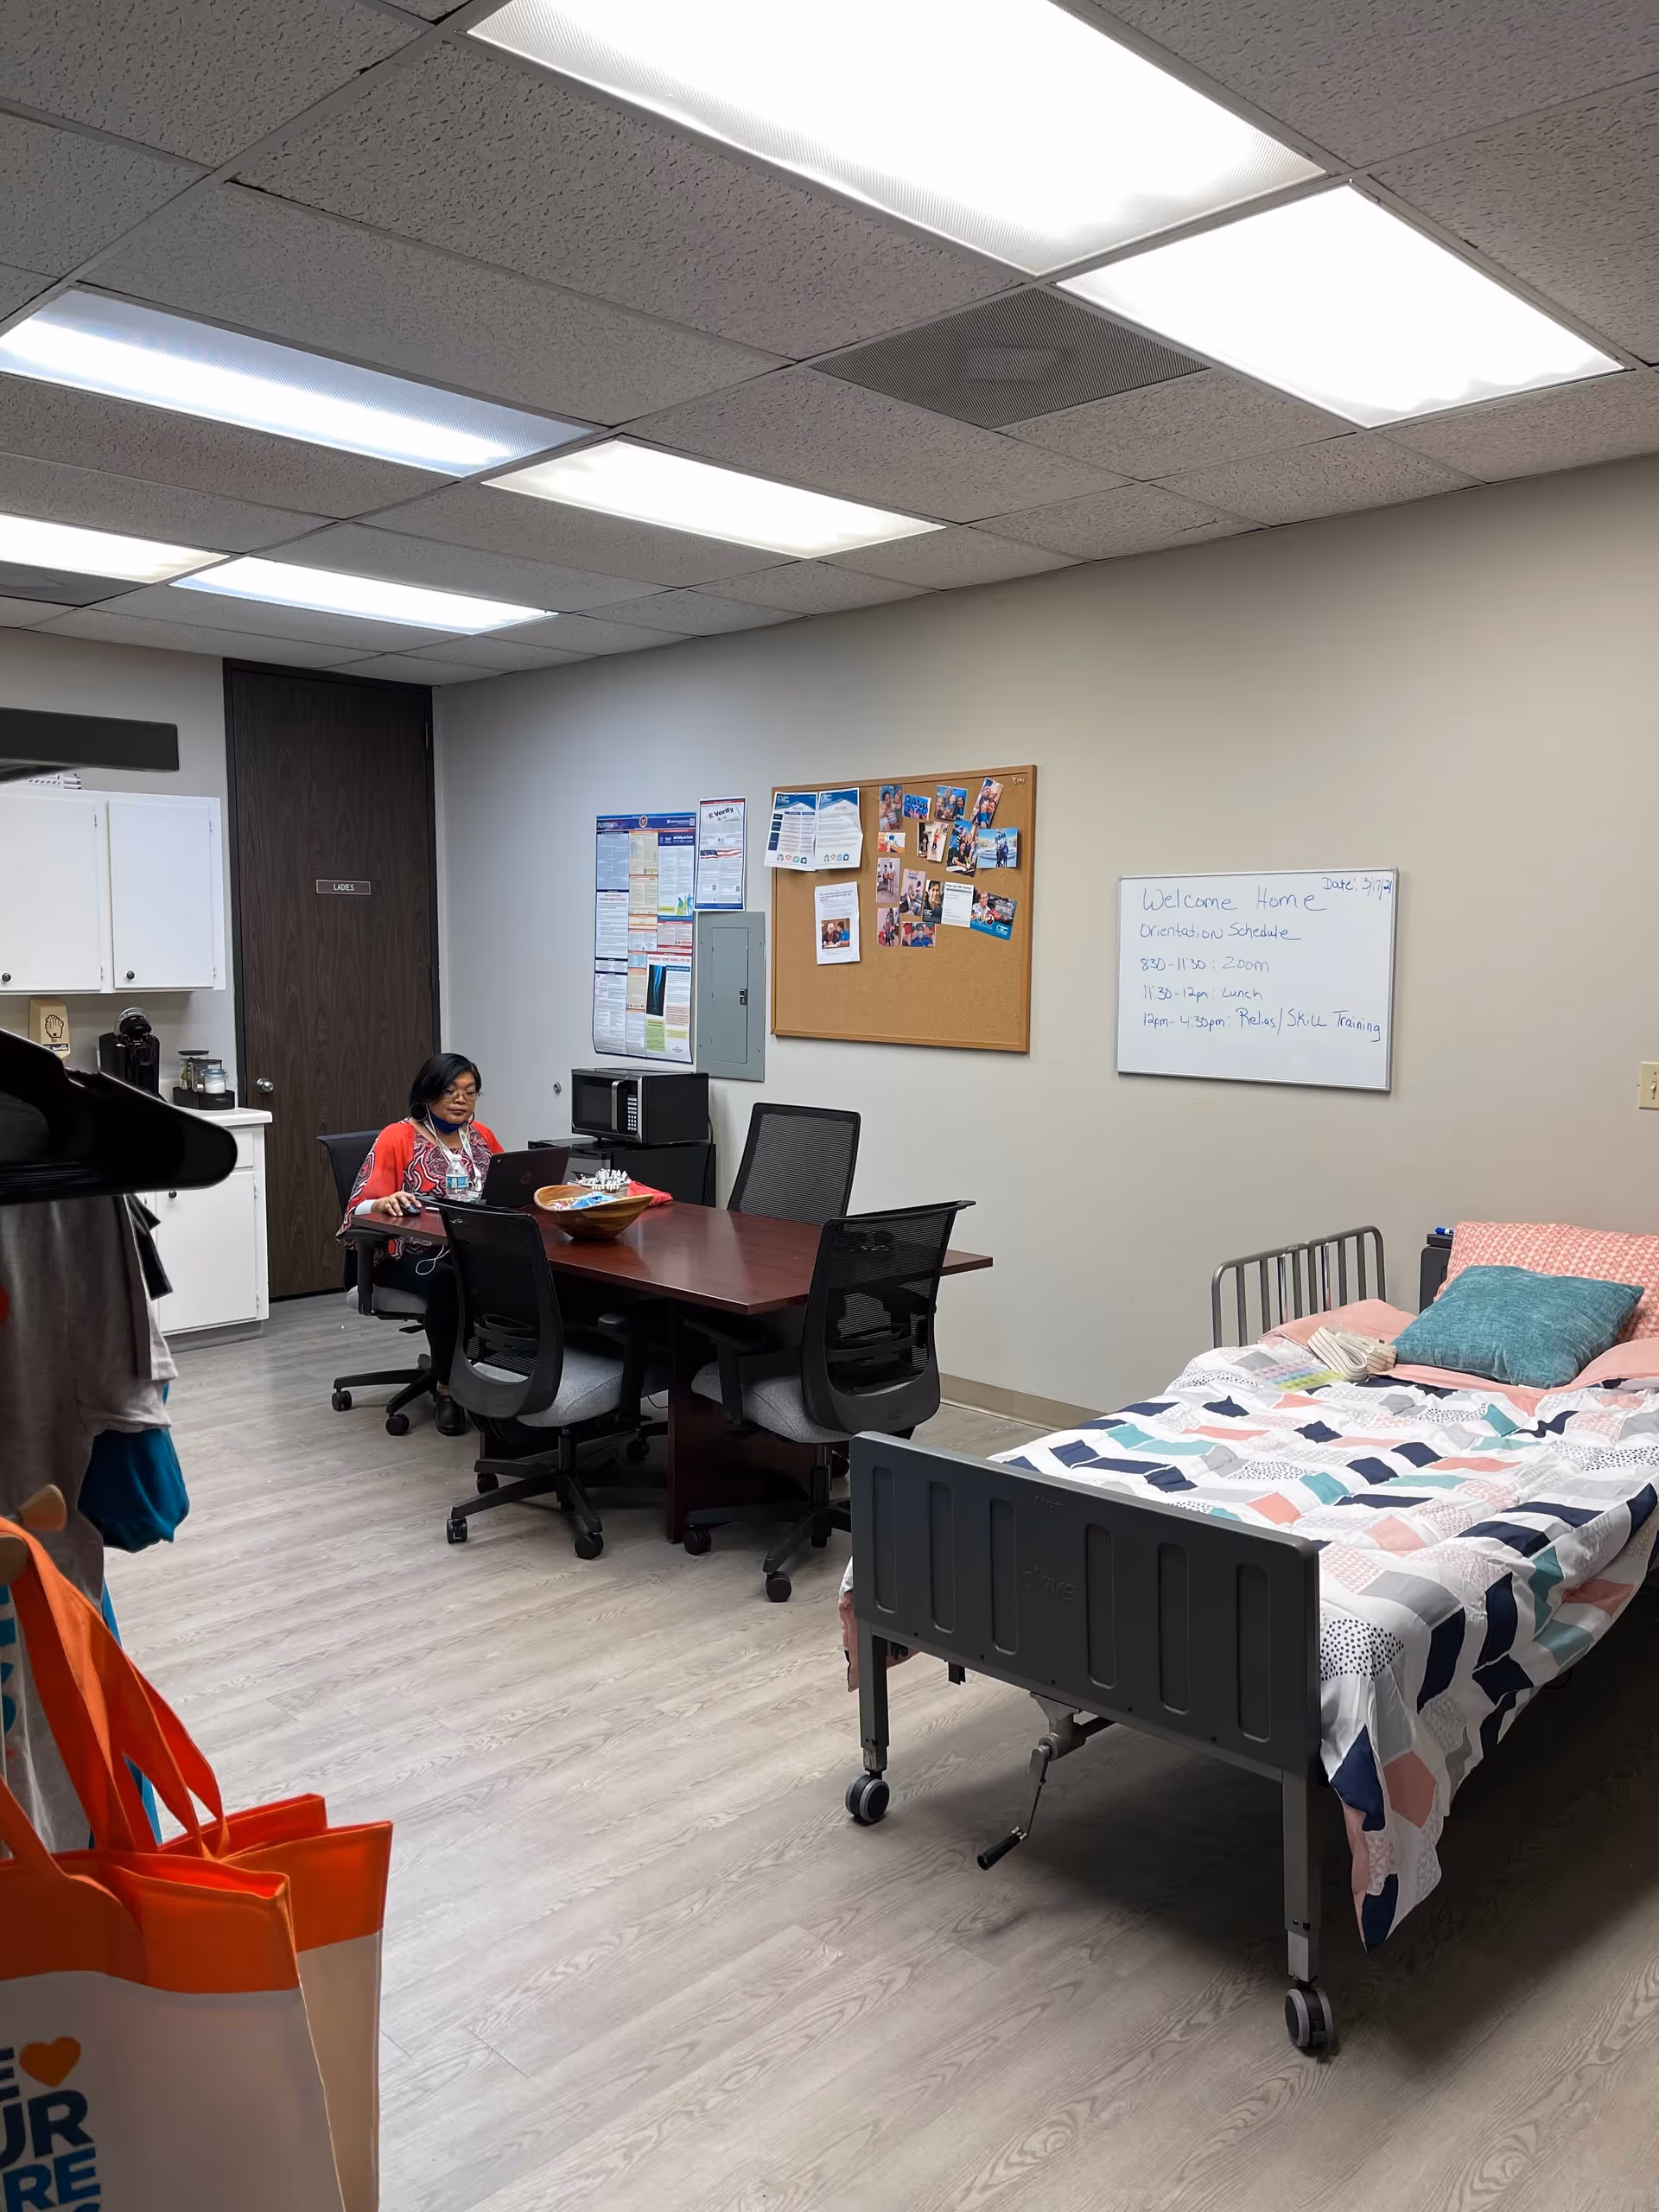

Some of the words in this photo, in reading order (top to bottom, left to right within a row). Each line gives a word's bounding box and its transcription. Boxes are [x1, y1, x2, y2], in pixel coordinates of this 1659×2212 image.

[333, 883, 355, 892] LADIES
[1143, 888, 1238, 911] Welcome
[1256, 886, 1327, 912] Home
[1140, 922, 1224, 939] Orientation
[1228, 921, 1302, 940] Schedule
[1222, 956, 1269, 973] Zoom
[1222, 987, 1263, 1001] Lunch
[1332, 1009, 1382, 1043] Training
